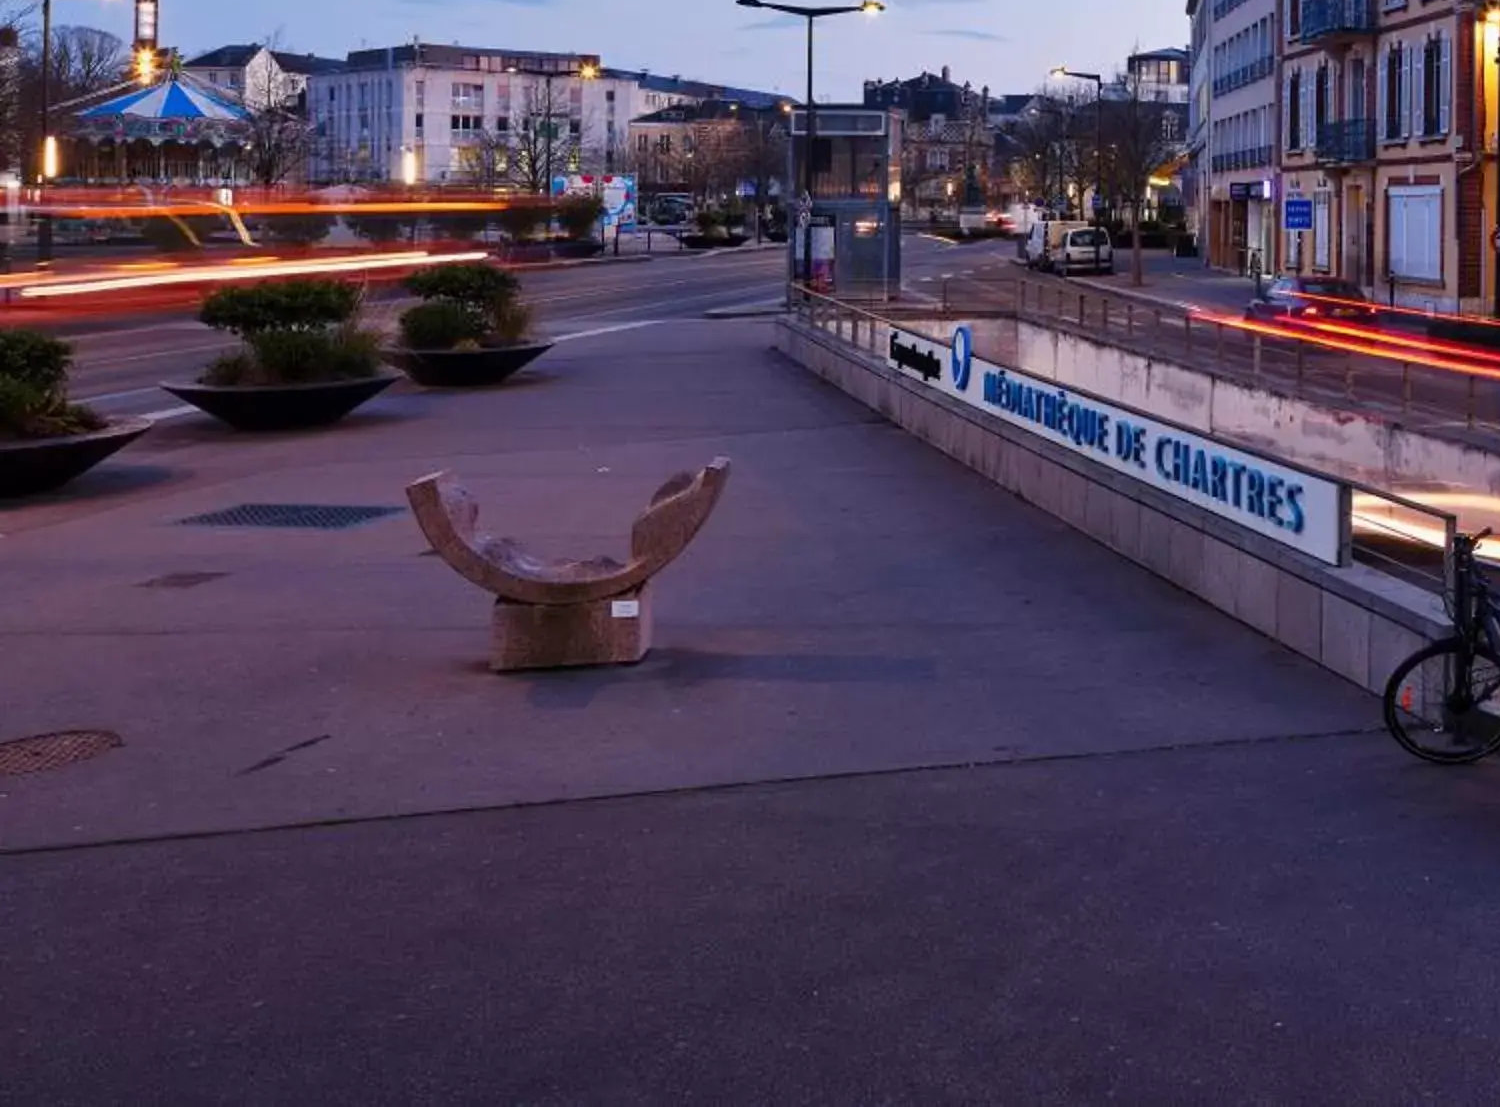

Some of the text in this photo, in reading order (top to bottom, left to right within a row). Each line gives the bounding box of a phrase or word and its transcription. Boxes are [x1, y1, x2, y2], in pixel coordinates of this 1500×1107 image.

[983, 369, 1305, 534] MÉDIATHÈQUE DE CHARTRES
